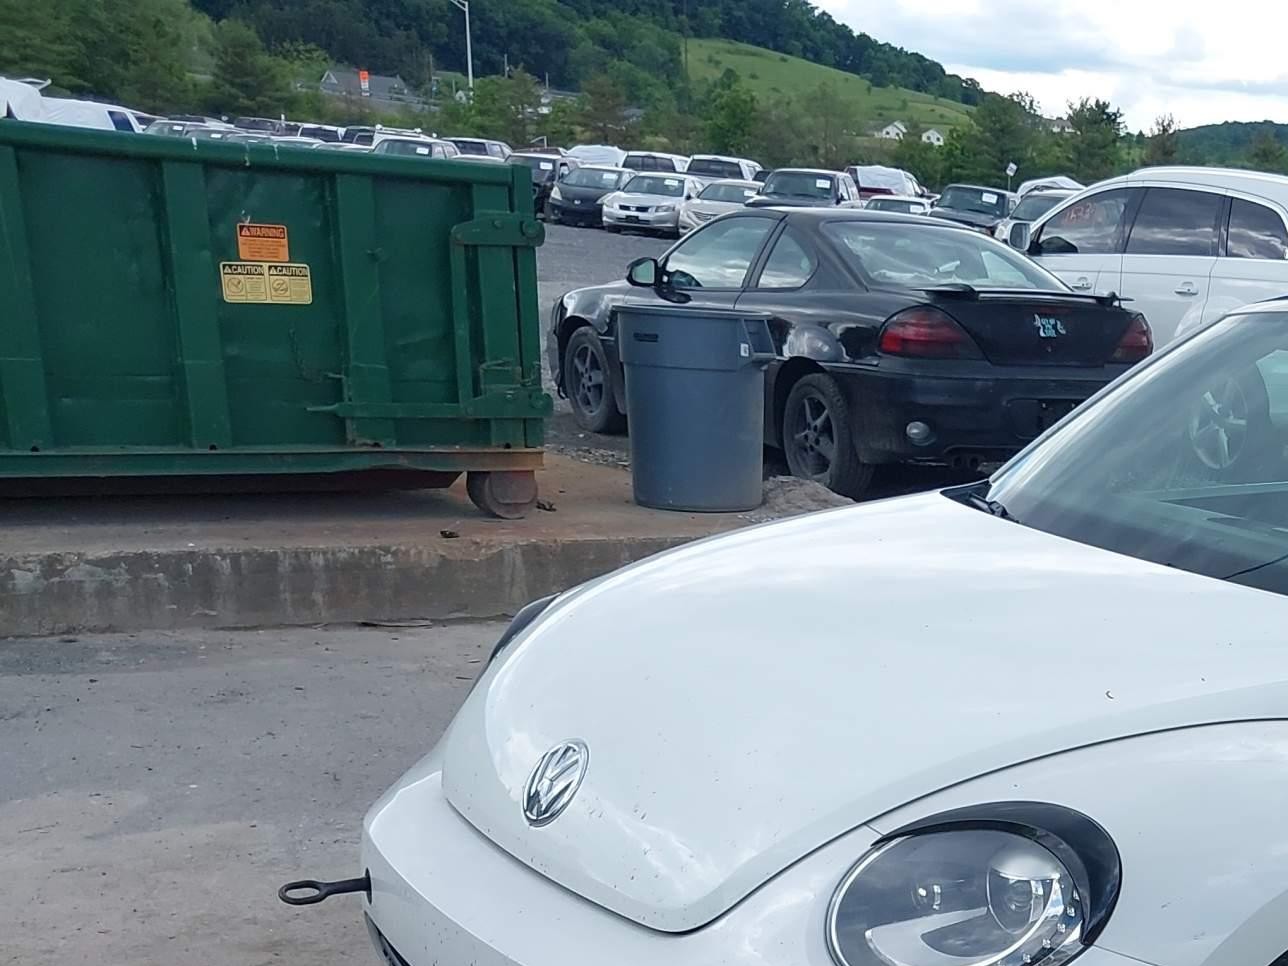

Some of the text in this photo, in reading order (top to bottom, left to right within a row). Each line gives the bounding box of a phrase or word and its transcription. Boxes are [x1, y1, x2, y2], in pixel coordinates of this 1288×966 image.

[249, 227, 285, 238] WARNING
[231, 265, 264, 275] CAUTION
[277, 266, 308, 277] CAUTION
